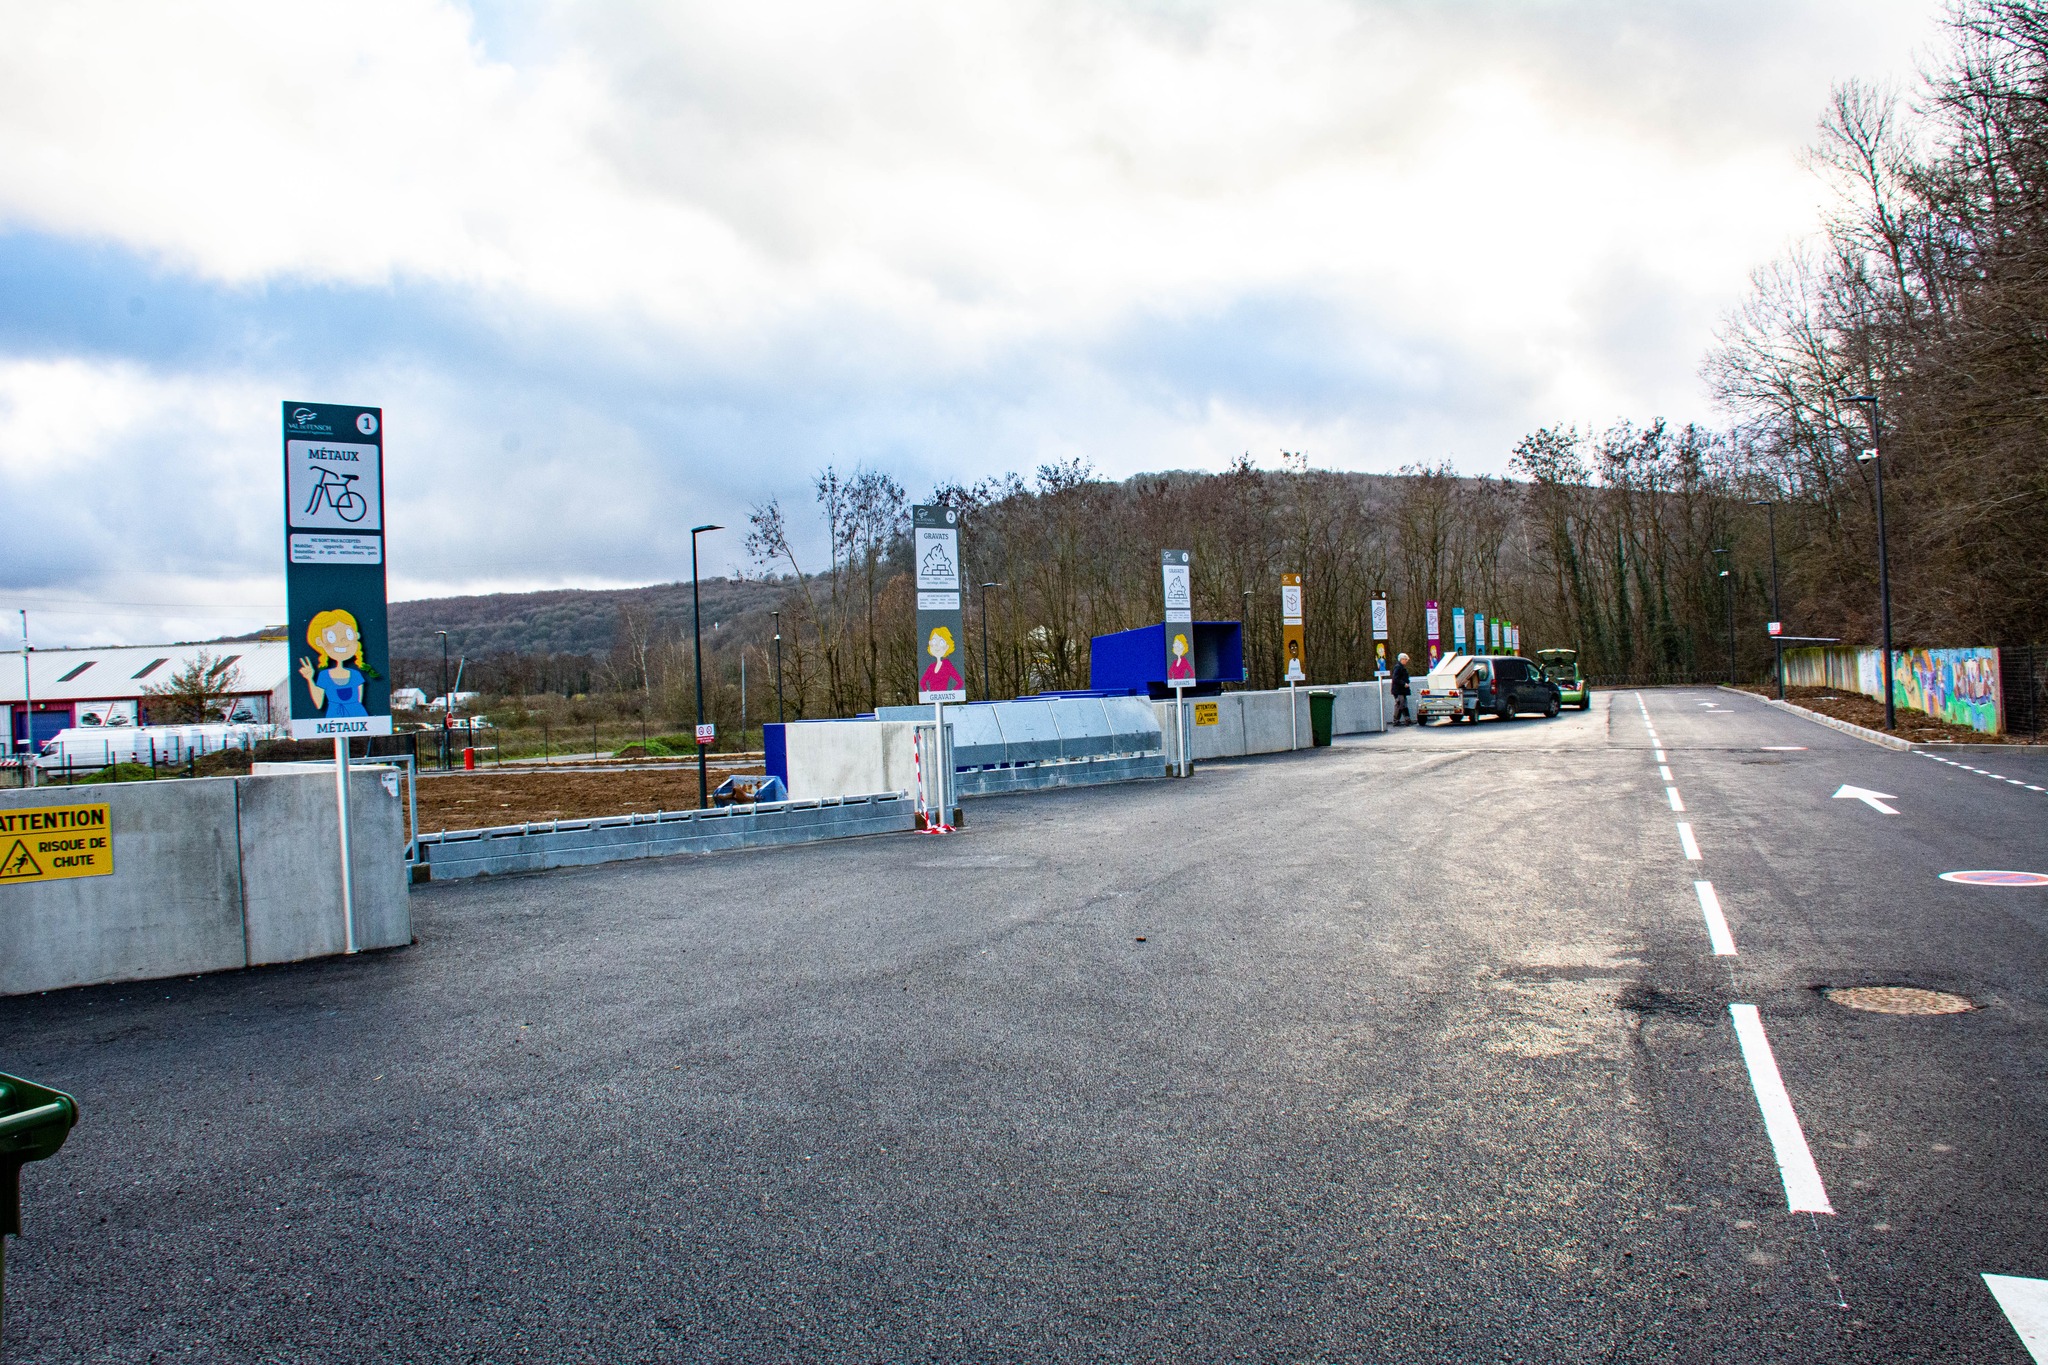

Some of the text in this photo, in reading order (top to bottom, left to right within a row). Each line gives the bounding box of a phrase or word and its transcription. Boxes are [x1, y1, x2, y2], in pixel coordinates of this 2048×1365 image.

[364, 418, 371, 429] 1
[308, 448, 359, 461] MÉTAUX
[923, 532, 949, 540] GRAVATS
[316, 720, 368, 734] MÉTAUX
[38, 837, 107, 853] RISQUE DE
[53, 854, 95, 868] CHUTE
